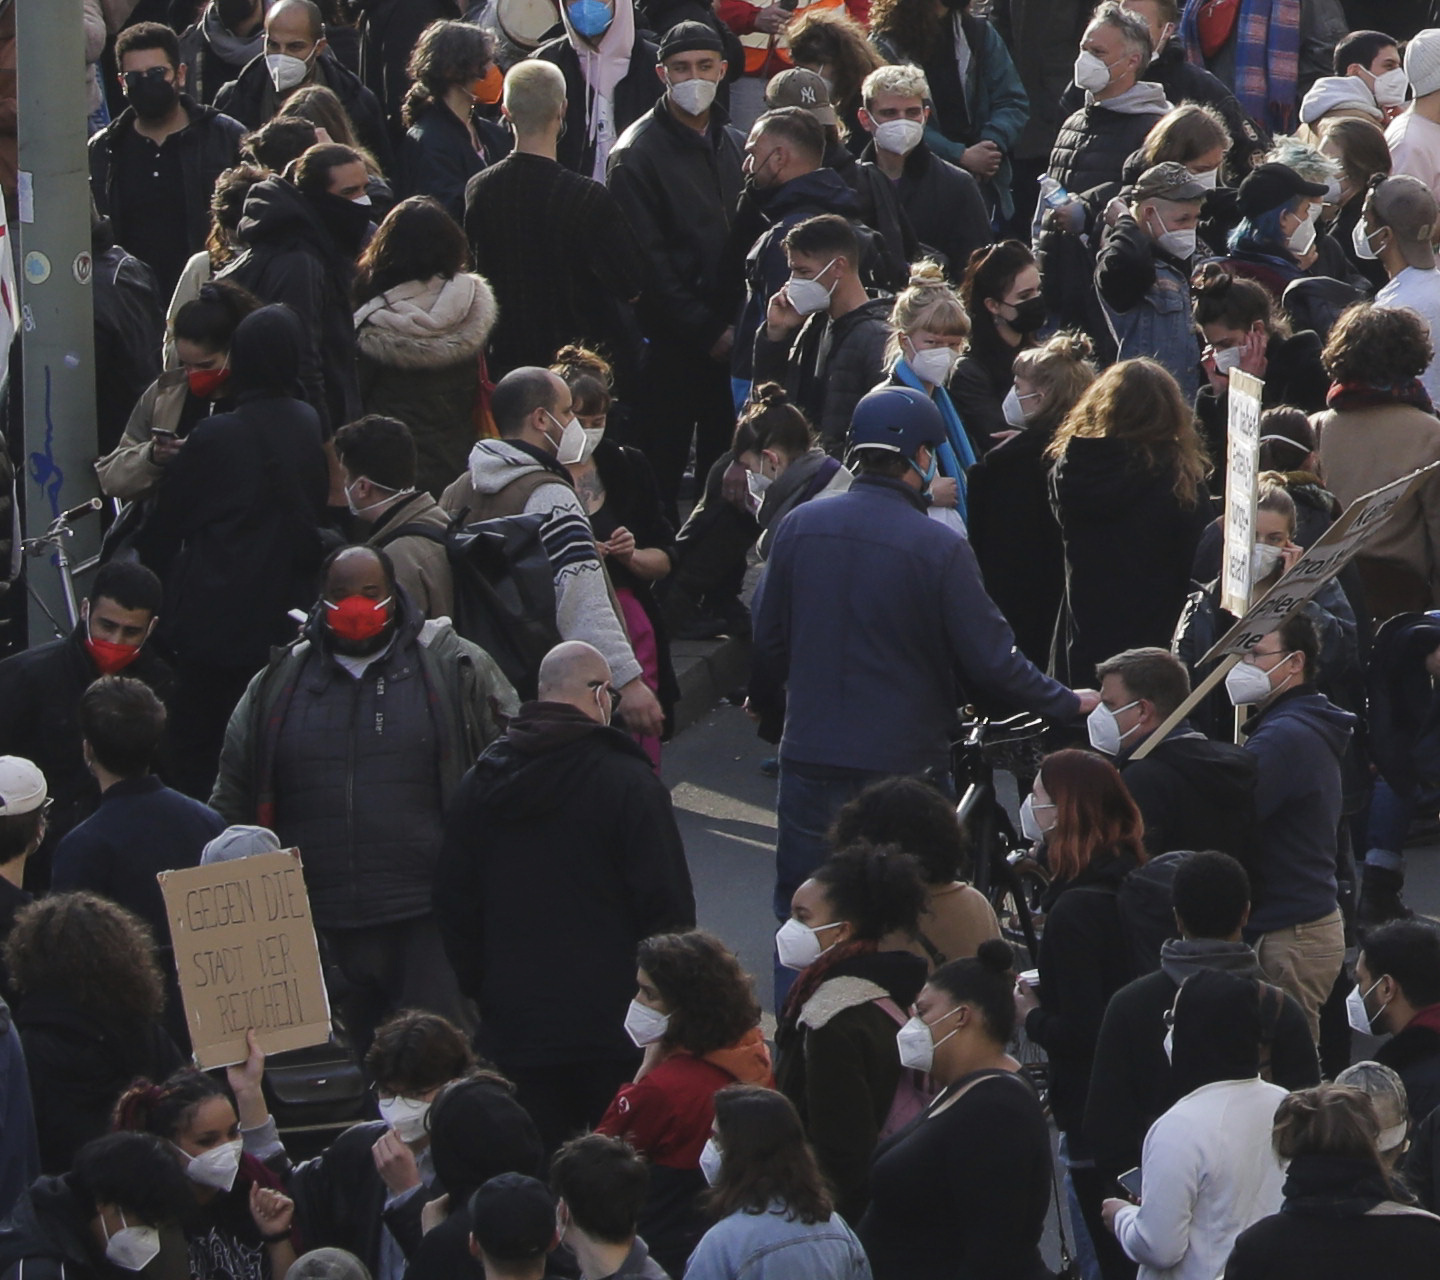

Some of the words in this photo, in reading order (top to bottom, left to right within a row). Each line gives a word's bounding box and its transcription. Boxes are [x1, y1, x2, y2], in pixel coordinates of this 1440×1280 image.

[186, 879, 257, 932] GEGEN
[261, 869, 305, 922] DIE
[193, 946, 244, 988] STADT
[257, 932, 297, 978] DER
[216, 978, 304, 1036] REICHEN
